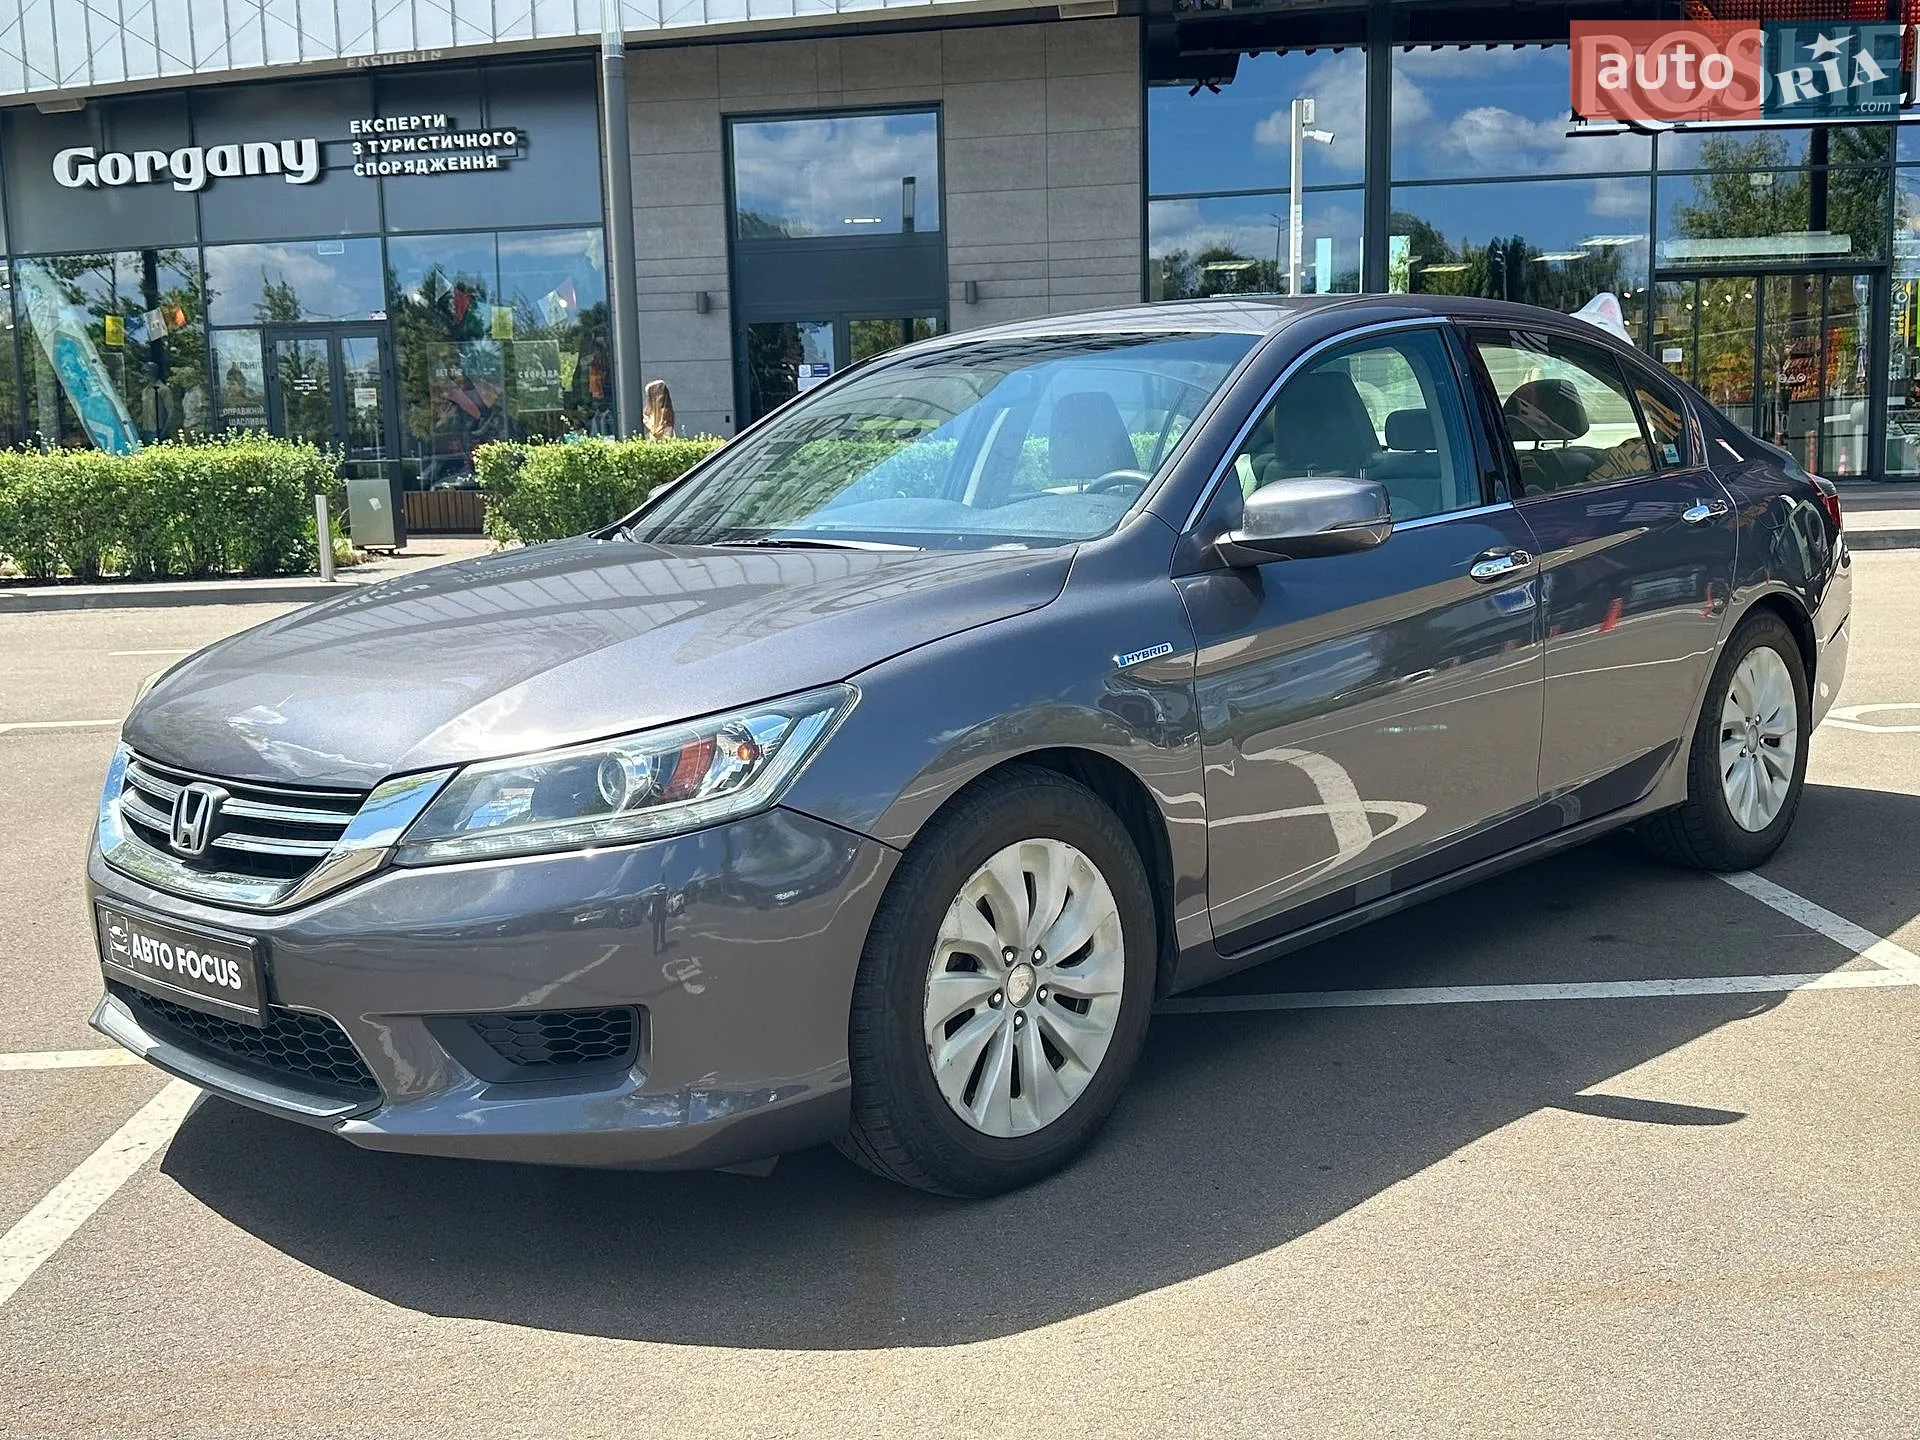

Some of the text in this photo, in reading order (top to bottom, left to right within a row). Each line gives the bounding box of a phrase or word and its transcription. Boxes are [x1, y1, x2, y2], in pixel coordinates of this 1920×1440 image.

[1579, 22, 1920, 129] ROSHE
[350, 114, 446, 134] ЕКСПЕРТИ
[368, 131, 516, 154] ТУРИСТИЧНОГО
[53, 138, 320, 192] Gorgany
[353, 155, 498, 177] СПОРЯДЖЕННЯ
[1126, 644, 1169, 664] HYBRID
[175, 946, 242, 990] FOCUS
